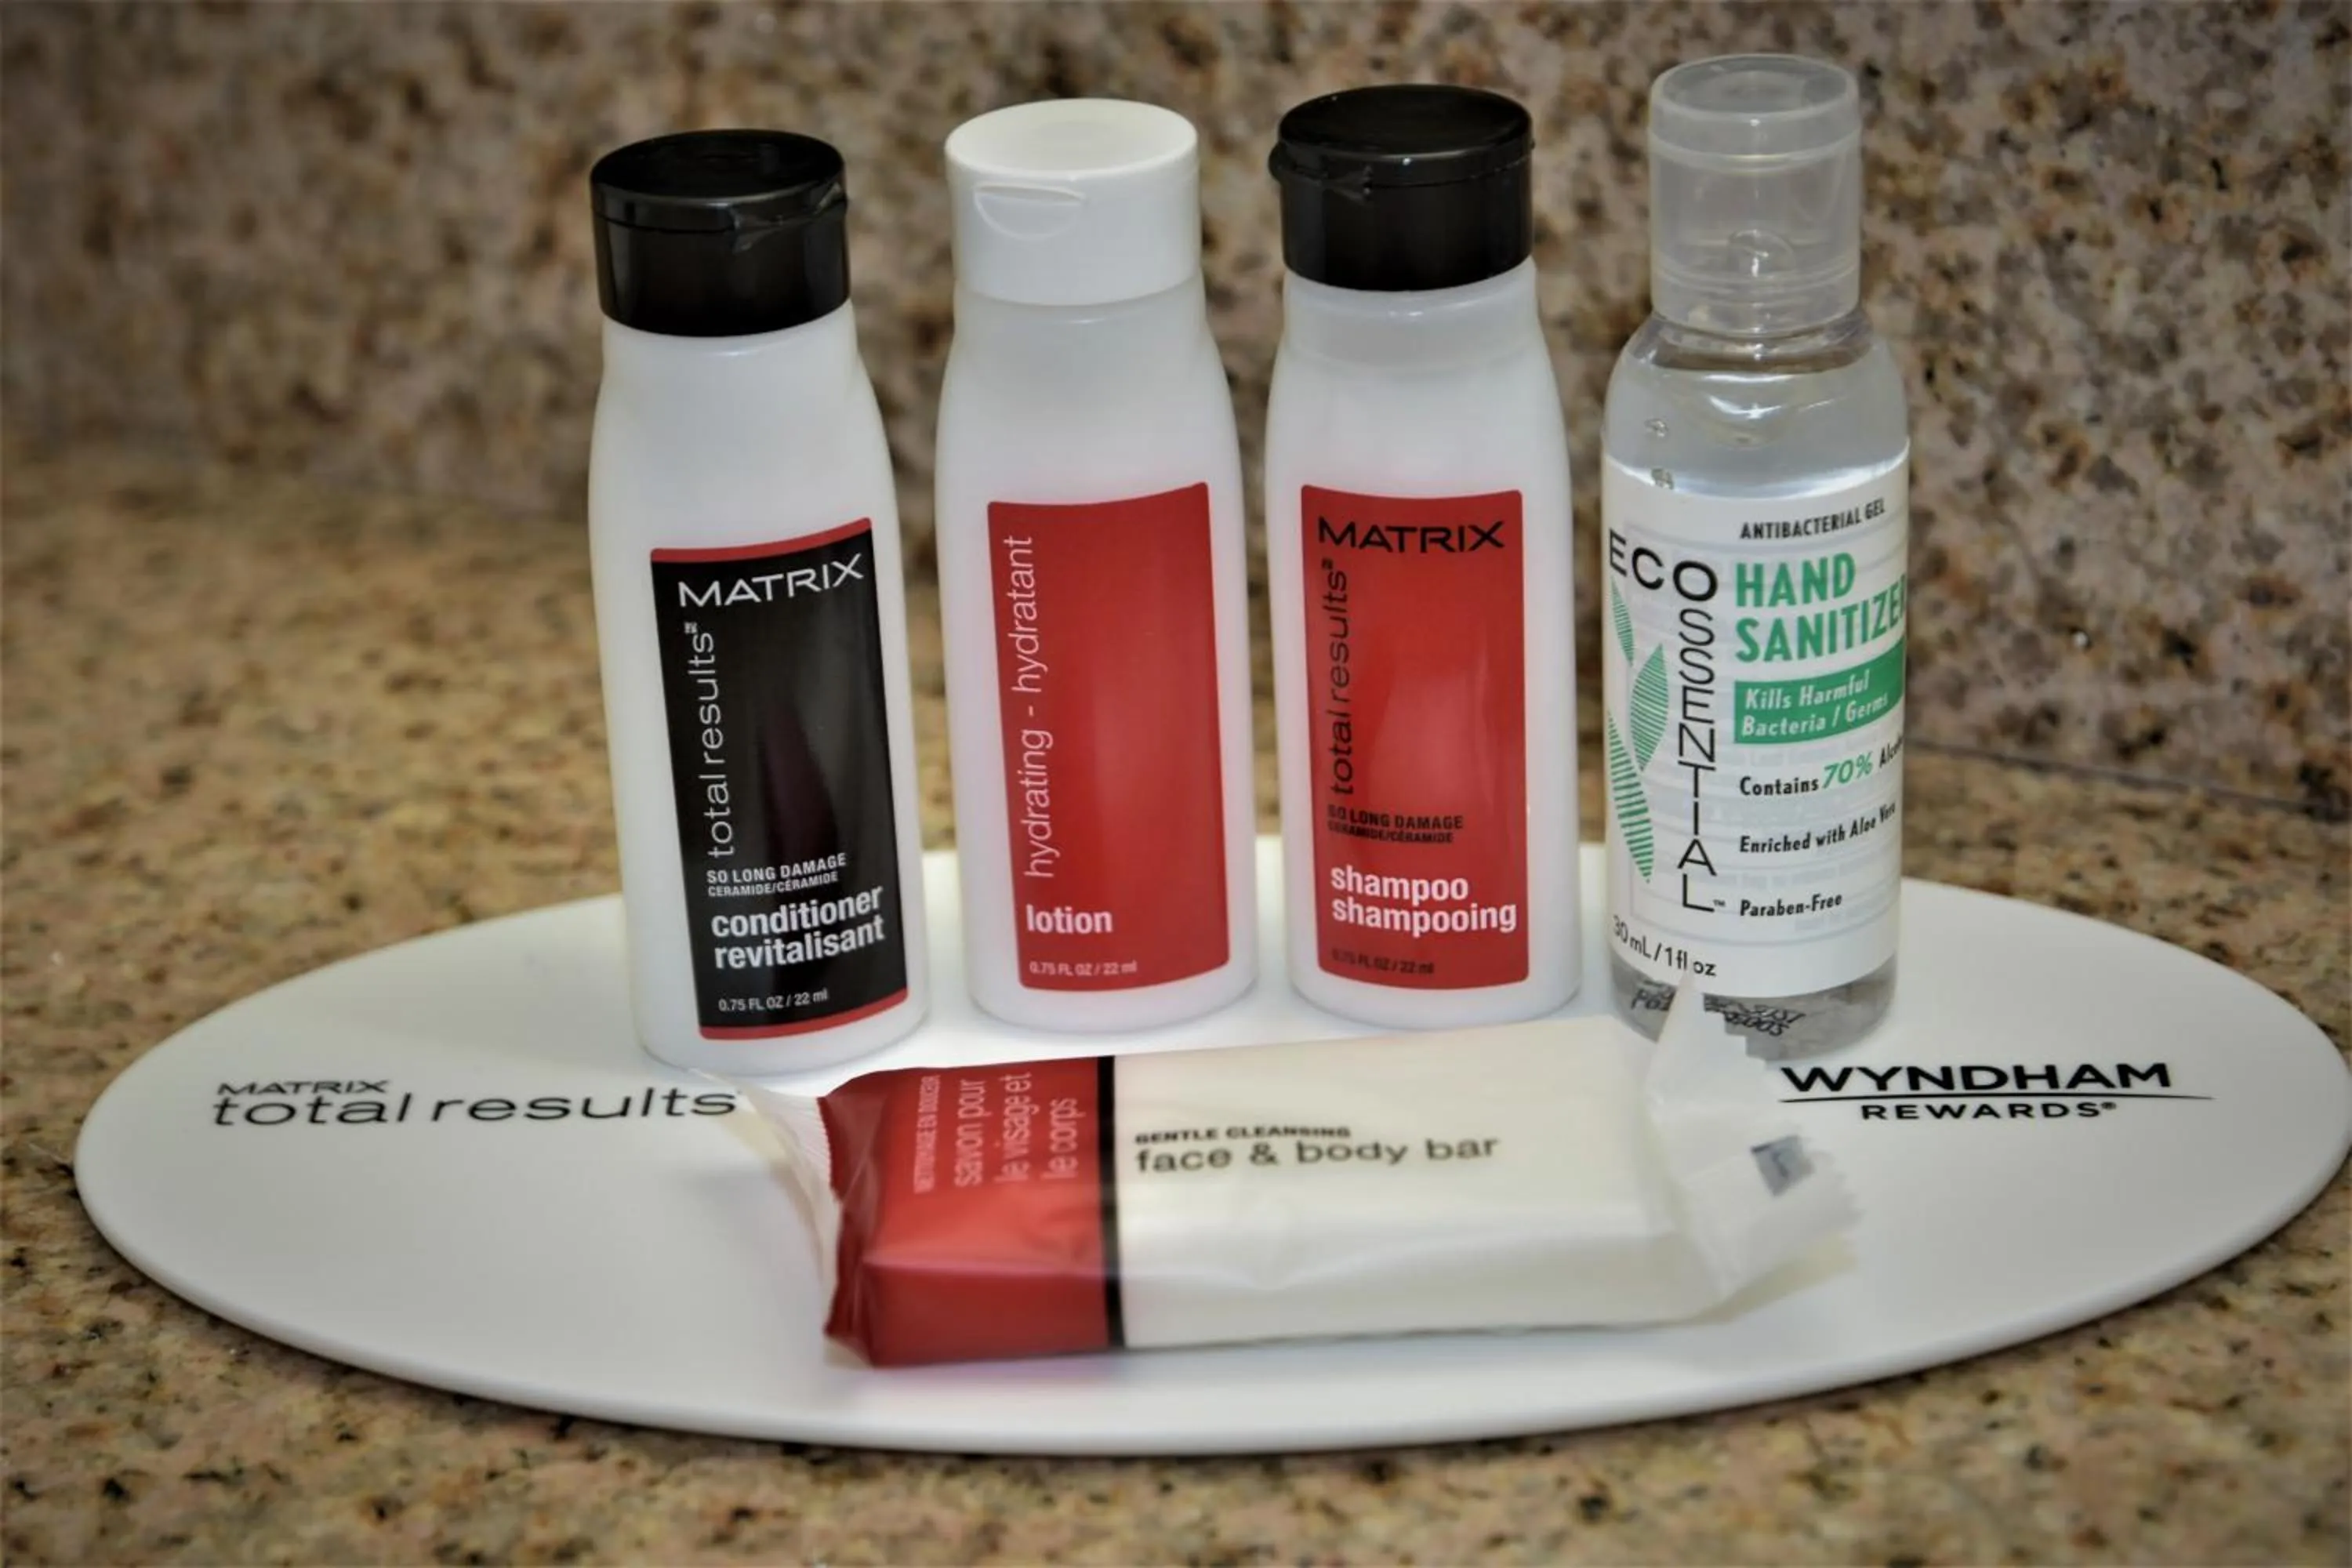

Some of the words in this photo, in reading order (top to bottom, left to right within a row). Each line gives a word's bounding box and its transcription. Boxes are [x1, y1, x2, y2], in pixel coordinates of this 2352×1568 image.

[1318, 516, 1504, 554] MATRIX
[1740, 512, 1861, 539] ANTIBACTERIAL
[1864, 497, 1886, 521] GEL
[677, 553, 864, 607] MATRIX
[1735, 552, 1856, 608] HAND
[1003, 535, 1048, 693] hydratant
[1744, 688, 1792, 710] Kills
[1798, 670, 1870, 707] Harmful
[1742, 714, 1826, 737] Bacteria
[1845, 693, 1889, 724] Germs
[1326, 709, 1355, 796] total
[1740, 775, 1820, 797] Contains
[1822, 751, 1873, 789] 70%
[698, 774, 735, 858] total
[1017, 728, 1061, 879] hydrating
[1349, 808, 1391, 827] LONG
[1394, 814, 1464, 830] DAMAGE
[1740, 831, 1810, 854] Enriched
[1816, 824, 1846, 848] with
[1849, 816, 1876, 838] Aloe
[707, 869, 728, 884] SO
[733, 866, 776, 883] LONG
[781, 852, 847, 879] DAMAGE
[1330, 864, 1468, 907] shampoo
[711, 885, 884, 938] conditioner
[1025, 903, 1113, 935] lotion
[1332, 896, 1517, 938] shampooing
[1739, 892, 1842, 916] Paraben-Free
[714, 914, 886, 969] revitalisant
[1076, 962, 1092, 976] OZ
[1693, 961, 1717, 977] oz
[718, 996, 746, 1012] 0.75
[749, 996, 764, 1011] FL
[767, 995, 783, 1010] OZ
[794, 990, 811, 1006] 22
[813, 988, 829, 1003] ml
[217, 1080, 390, 1096] MATRIX
[999, 1072, 1033, 1092] et
[1780, 1062, 2172, 1092] WYNDHAM
[212, 1092, 412, 1126] total
[431, 1087, 737, 1122] results
[956, 1078, 992, 1119] pour
[993, 1094, 1040, 1160] visage
[1047, 1098, 1086, 1152] corps
[1134, 1127, 1219, 1145] GENTLE
[1225, 1124, 1352, 1141] CLEANSING
[953, 1123, 983, 1187] savon
[993, 1161, 1030, 1183] le
[1040, 1156, 1077, 1180] le
[1134, 1146, 1233, 1174] face
[1249, 1142, 1279, 1167] &
[1294, 1139, 1409, 1166] body
[1425, 1136, 1500, 1162] bar
